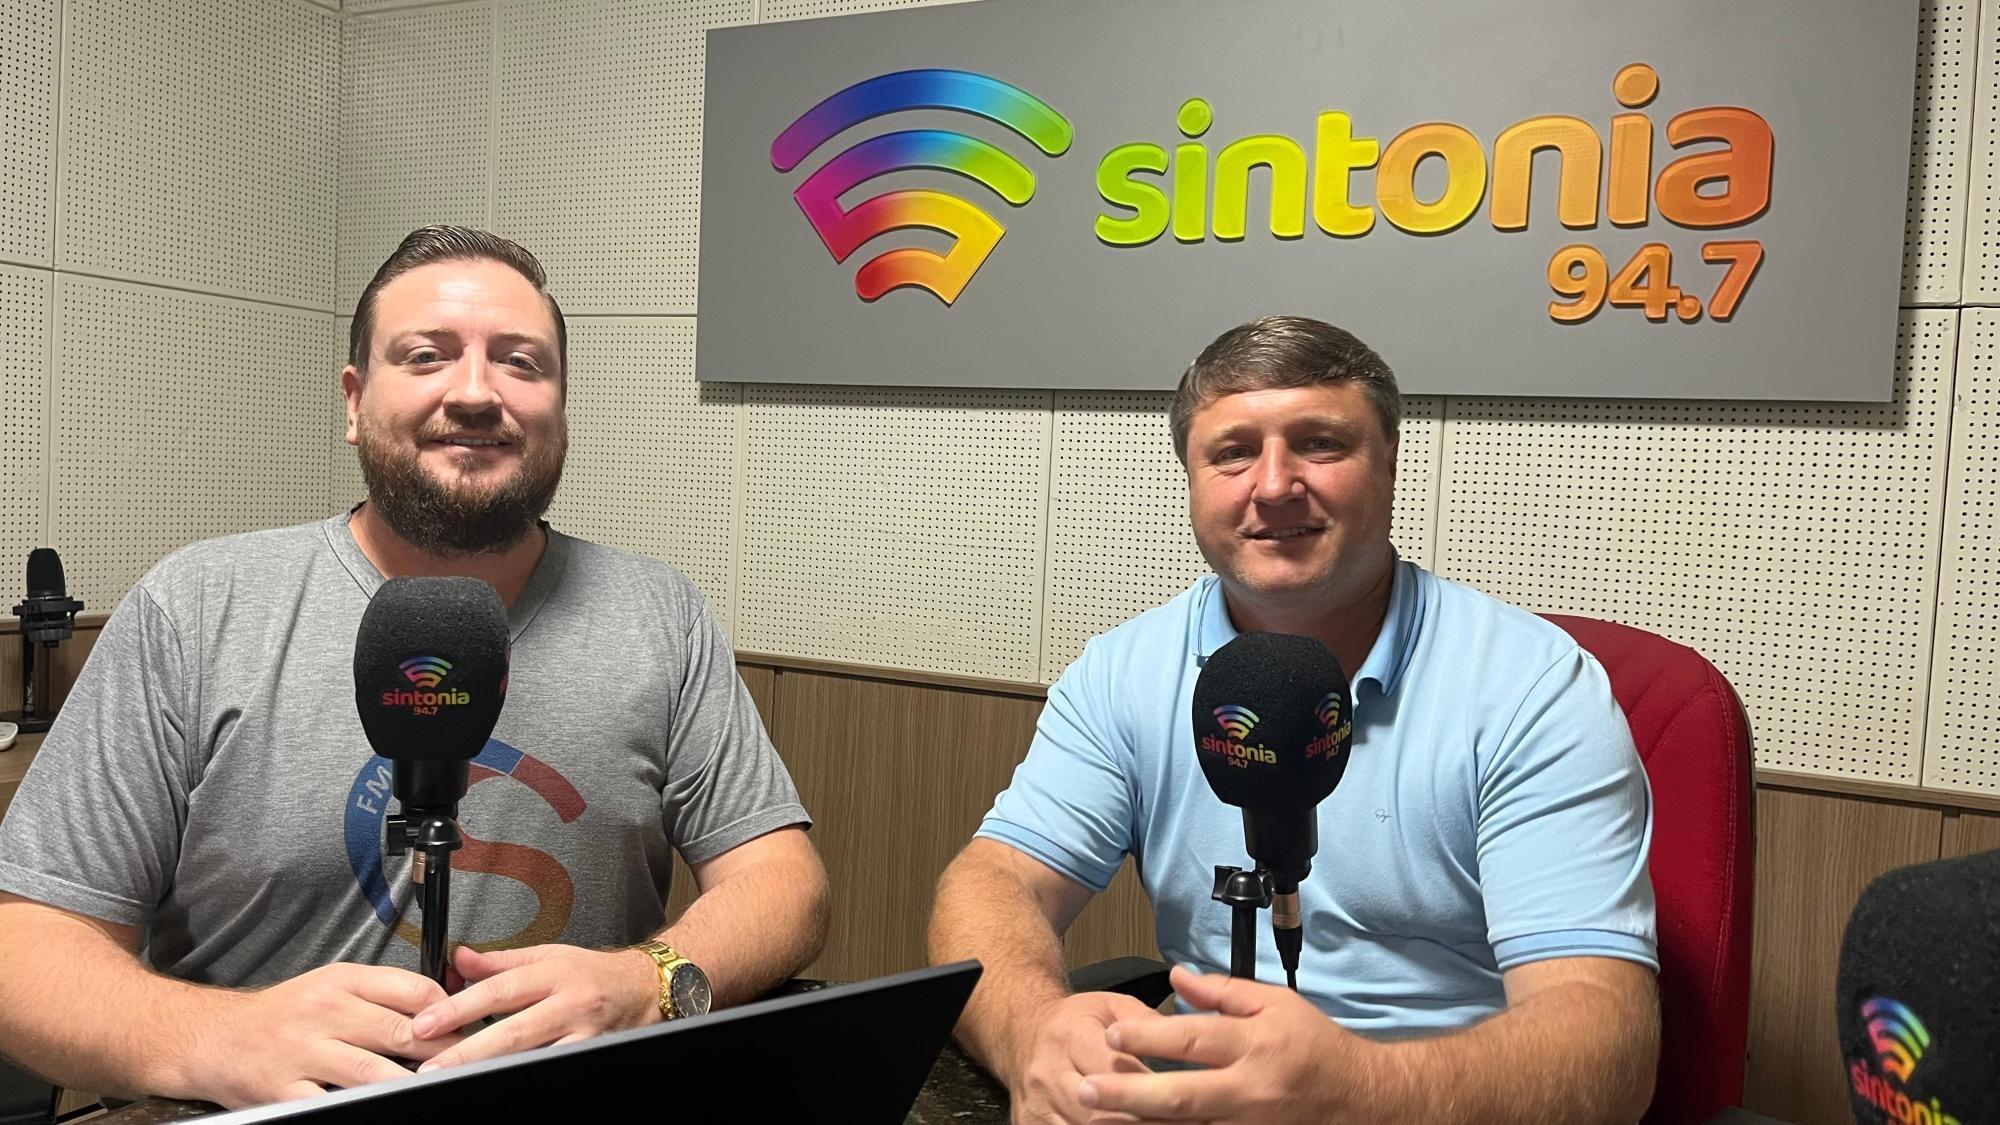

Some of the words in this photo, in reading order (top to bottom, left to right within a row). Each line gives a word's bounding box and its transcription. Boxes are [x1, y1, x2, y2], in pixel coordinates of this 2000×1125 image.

[1095, 62, 1774, 245] sintonia
[1547, 240, 1764, 322] 94.7
[382, 687, 470, 706] sintonia
[413, 706, 438, 716] 94.7
[1202, 732, 1278, 765] sintonia
[357, 765, 393, 815] FM
